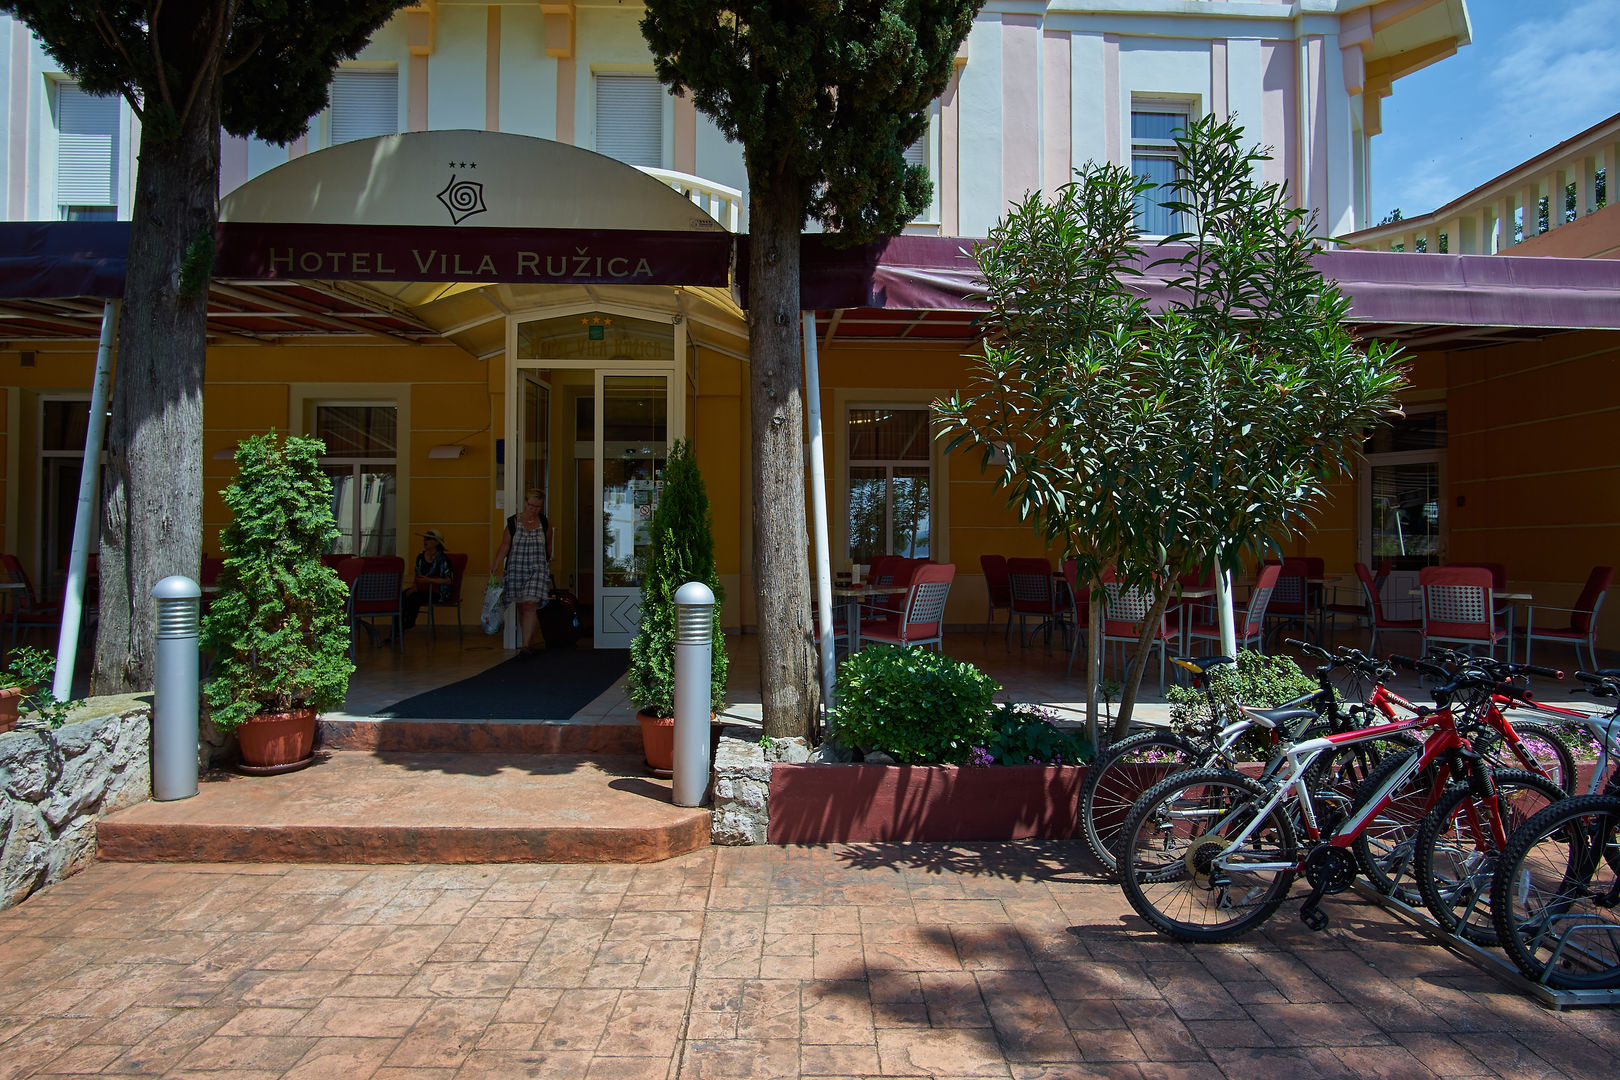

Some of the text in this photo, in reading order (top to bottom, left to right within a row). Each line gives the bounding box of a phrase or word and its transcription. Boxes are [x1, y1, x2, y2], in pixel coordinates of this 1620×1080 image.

[269, 246, 654, 278] HOTEL VILA RUŽICA
